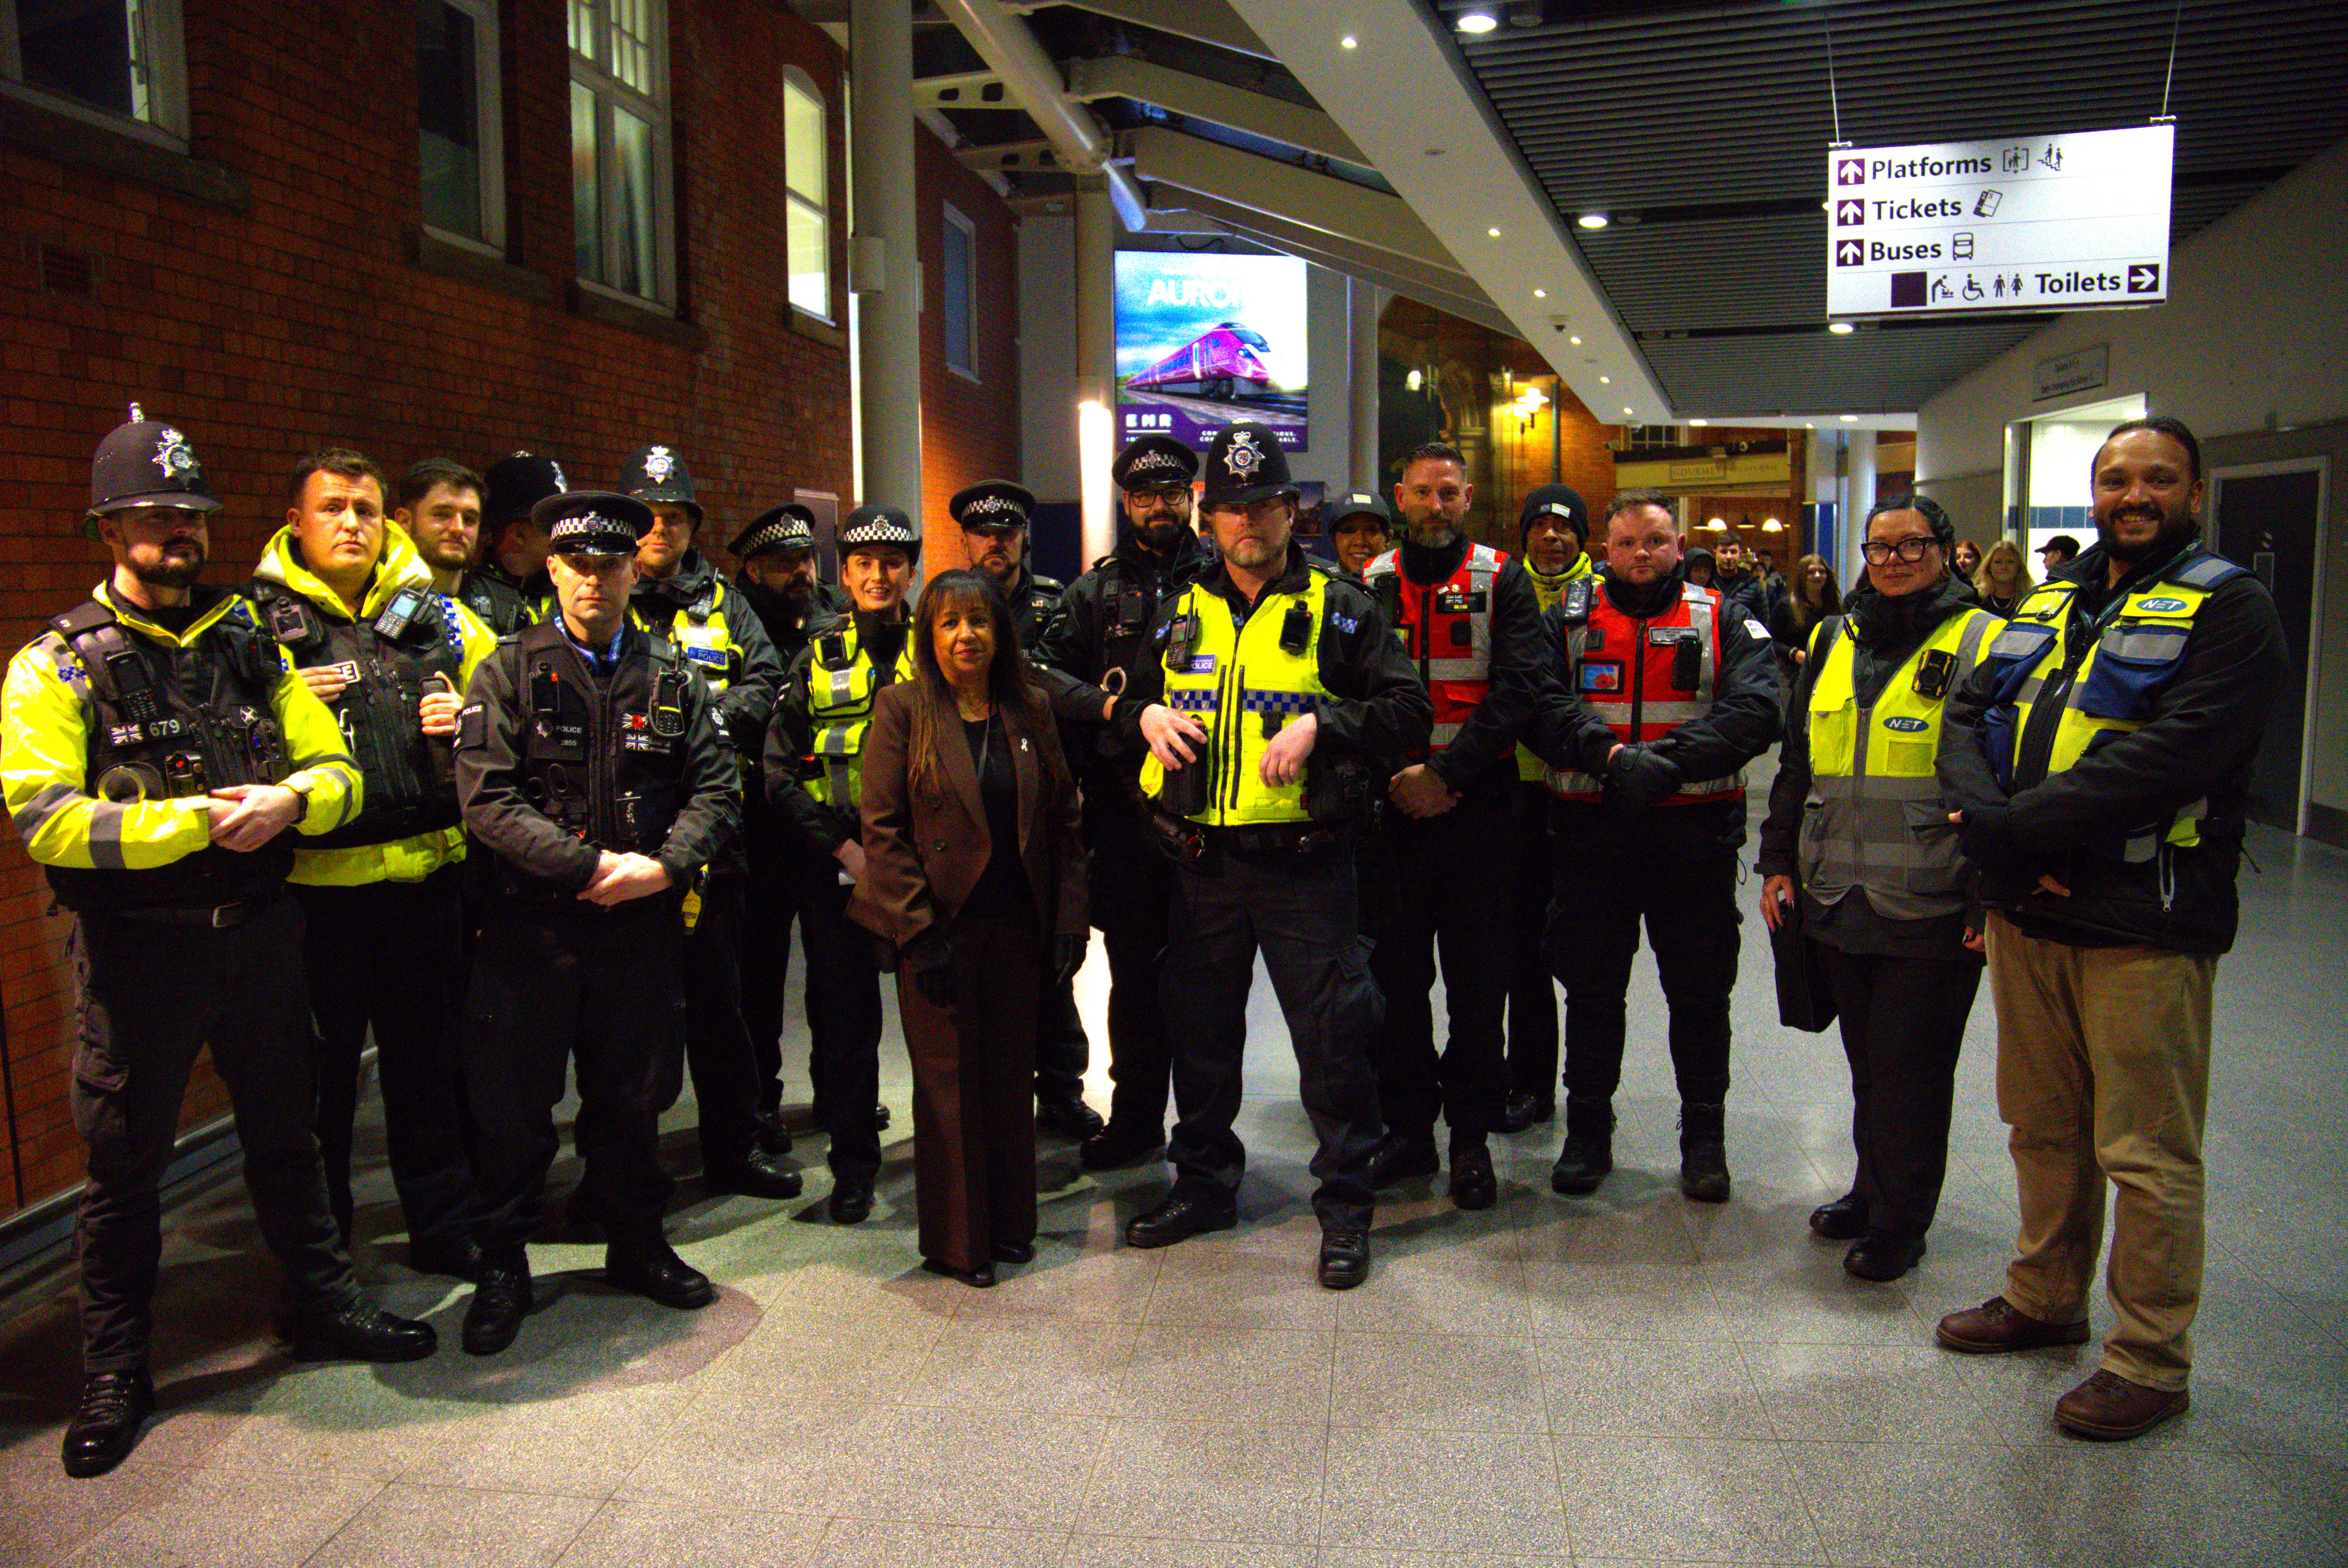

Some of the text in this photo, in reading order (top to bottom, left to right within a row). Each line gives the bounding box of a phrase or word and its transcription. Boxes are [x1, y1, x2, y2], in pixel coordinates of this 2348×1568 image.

[1872, 157, 1992, 180] Platforms
[1872, 198, 1962, 221] Tickets
[1871, 242, 1942, 262] Buses
[2035, 271, 2121, 295] Toilets
[2142, 600, 2182, 610] NET
[698, 652, 725, 664] POLICE
[462, 705, 483, 717] POLICE
[149, 719, 180, 737] 679
[556, 725, 582, 733] POLICE
[1889, 719, 1922, 729] NET
